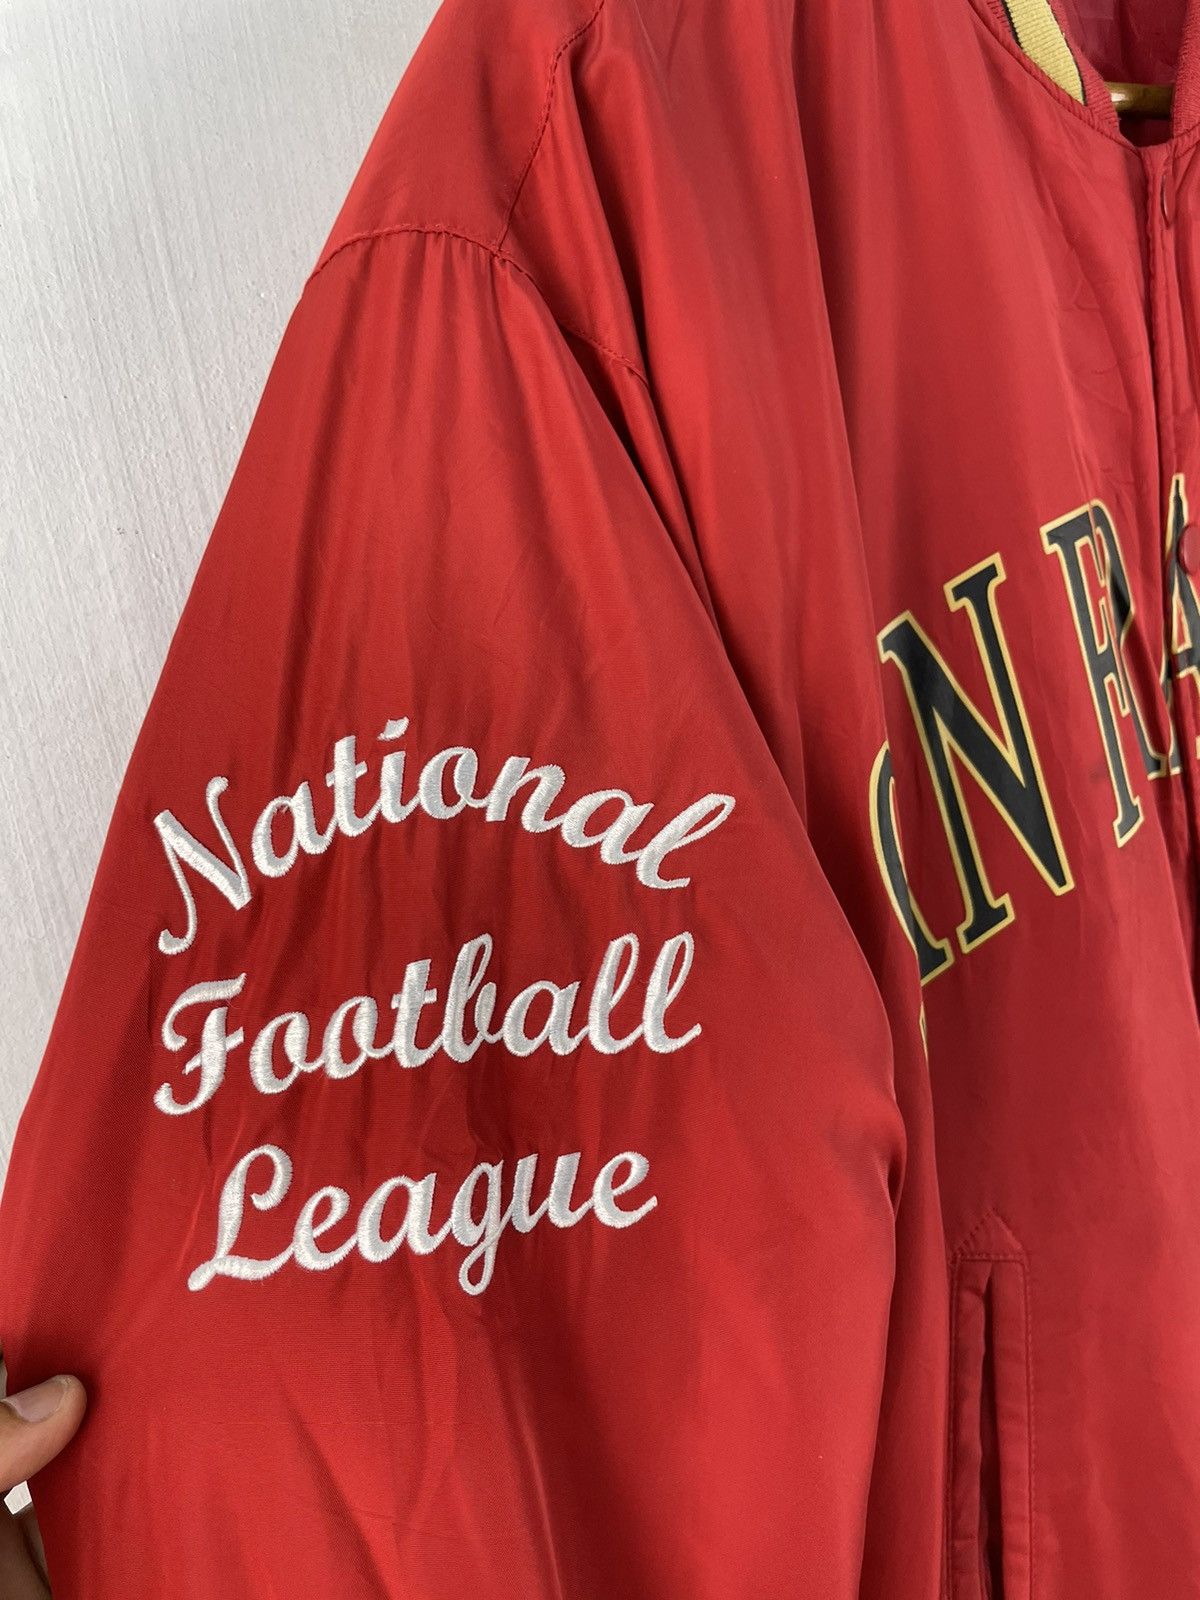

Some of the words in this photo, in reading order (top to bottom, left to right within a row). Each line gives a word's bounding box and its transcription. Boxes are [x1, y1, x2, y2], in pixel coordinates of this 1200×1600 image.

[153, 717, 737, 956] National
[154, 933, 703, 1116] Football
[188, 1145, 658, 1296] League
